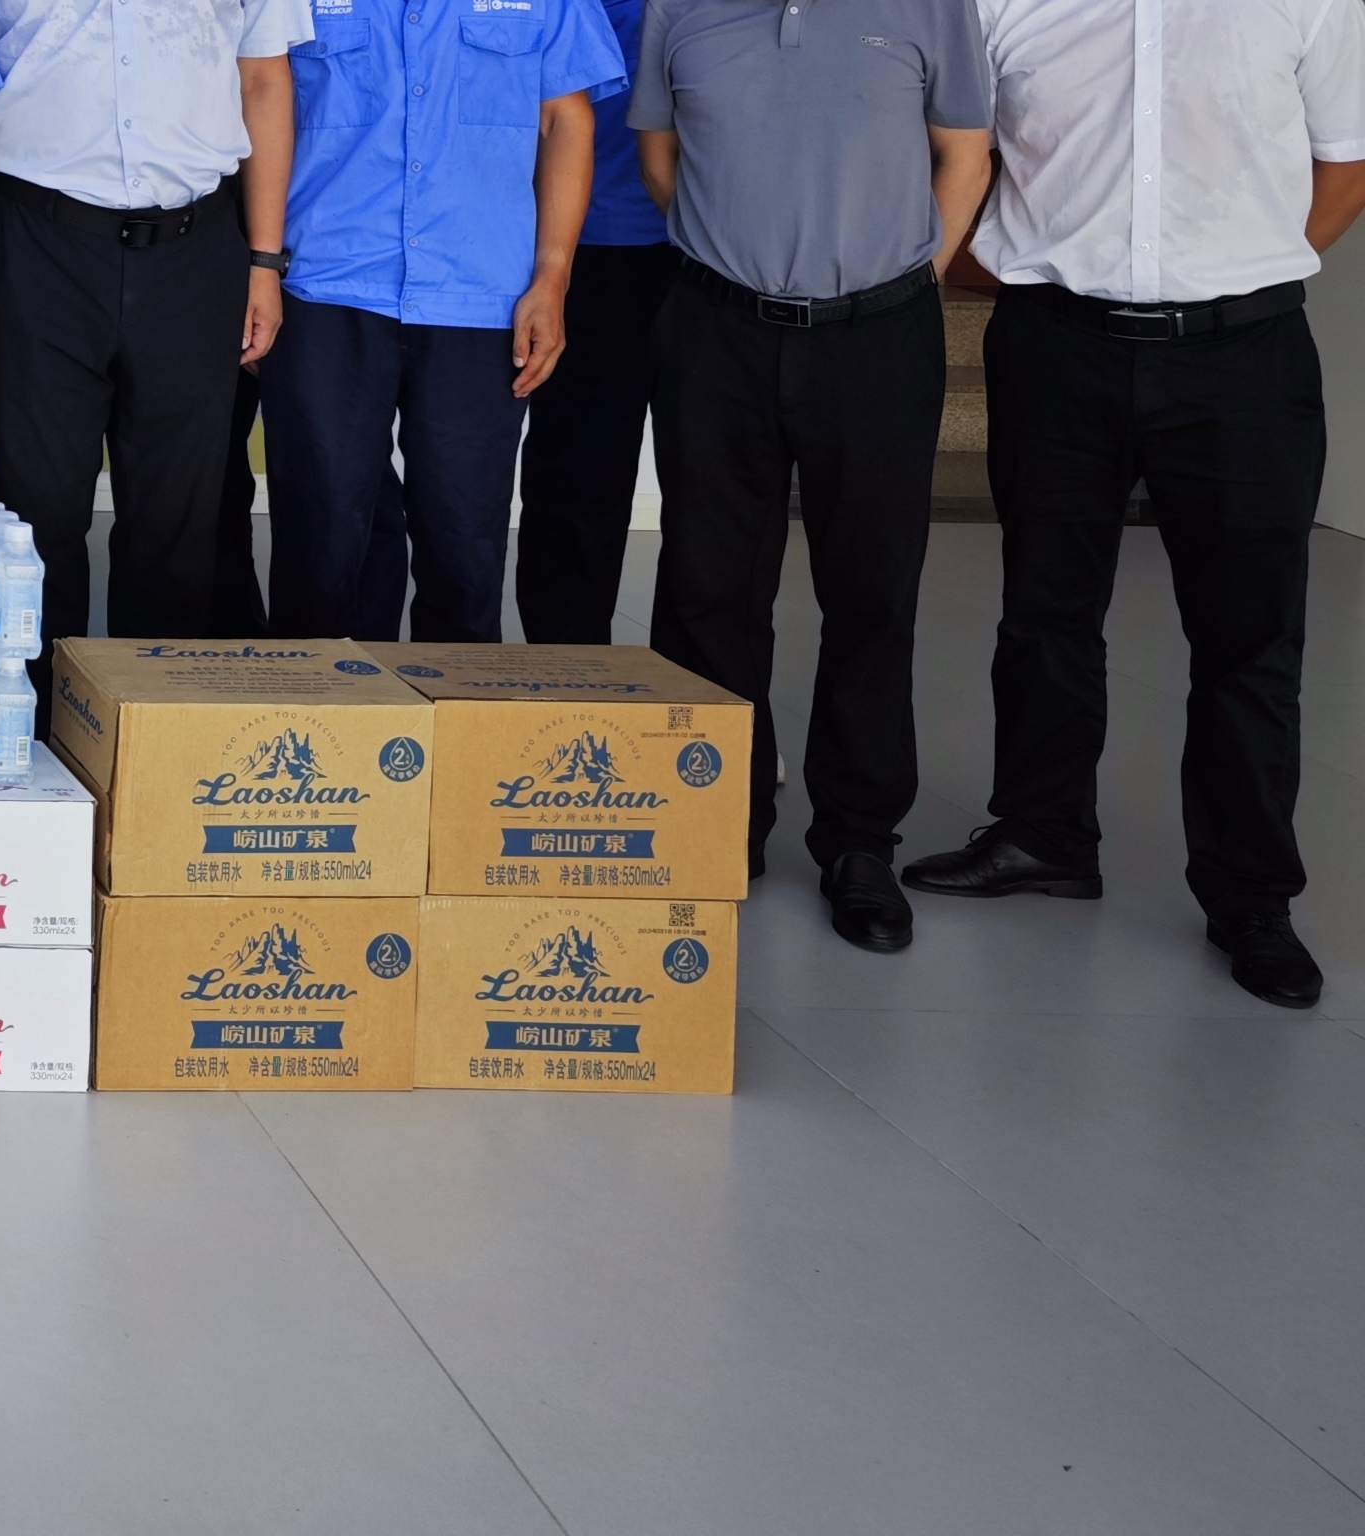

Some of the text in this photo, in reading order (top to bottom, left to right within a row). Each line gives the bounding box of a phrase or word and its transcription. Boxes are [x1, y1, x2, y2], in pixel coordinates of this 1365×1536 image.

[136, 646, 322, 659] Laoshan
[59, 676, 104, 736] Laoshan
[222, 737, 237, 757] TOO
[241, 715, 267, 733] RARE
[304, 716, 344, 757] PRECIOUS
[520, 739, 535, 759] TOO
[539, 718, 565, 735] RARE
[602, 719, 641, 761] PRECIOUS
[192, 773, 370, 806] Laoshan
[490, 776, 669, 809] Laoshan
[233, 829, 329, 849] 崂山矿泉
[532, 833, 627, 853] 崂山矿泉
[187, 862, 242, 883] 包装饮用水
[485, 865, 540, 886] 包装饮用水
[211, 932, 225, 952] TOO
[229, 909, 255, 928] RARE
[292, 912, 331, 953] PRECIOUS
[505, 933, 520, 953] TOO
[524, 912, 550, 929] RARE
[588, 914, 627, 956] PRECIOUS
[180, 968, 358, 1001] Laoshan
[475, 969, 654, 1003] Laoshan
[222, 1025, 316, 1045] 崂山矿泉
[516, 1026, 612, 1047] 崂山矿泉
[175, 1056, 229, 1077] 包装饮用水
[469, 1057, 524, 1078] 包装饮用水
